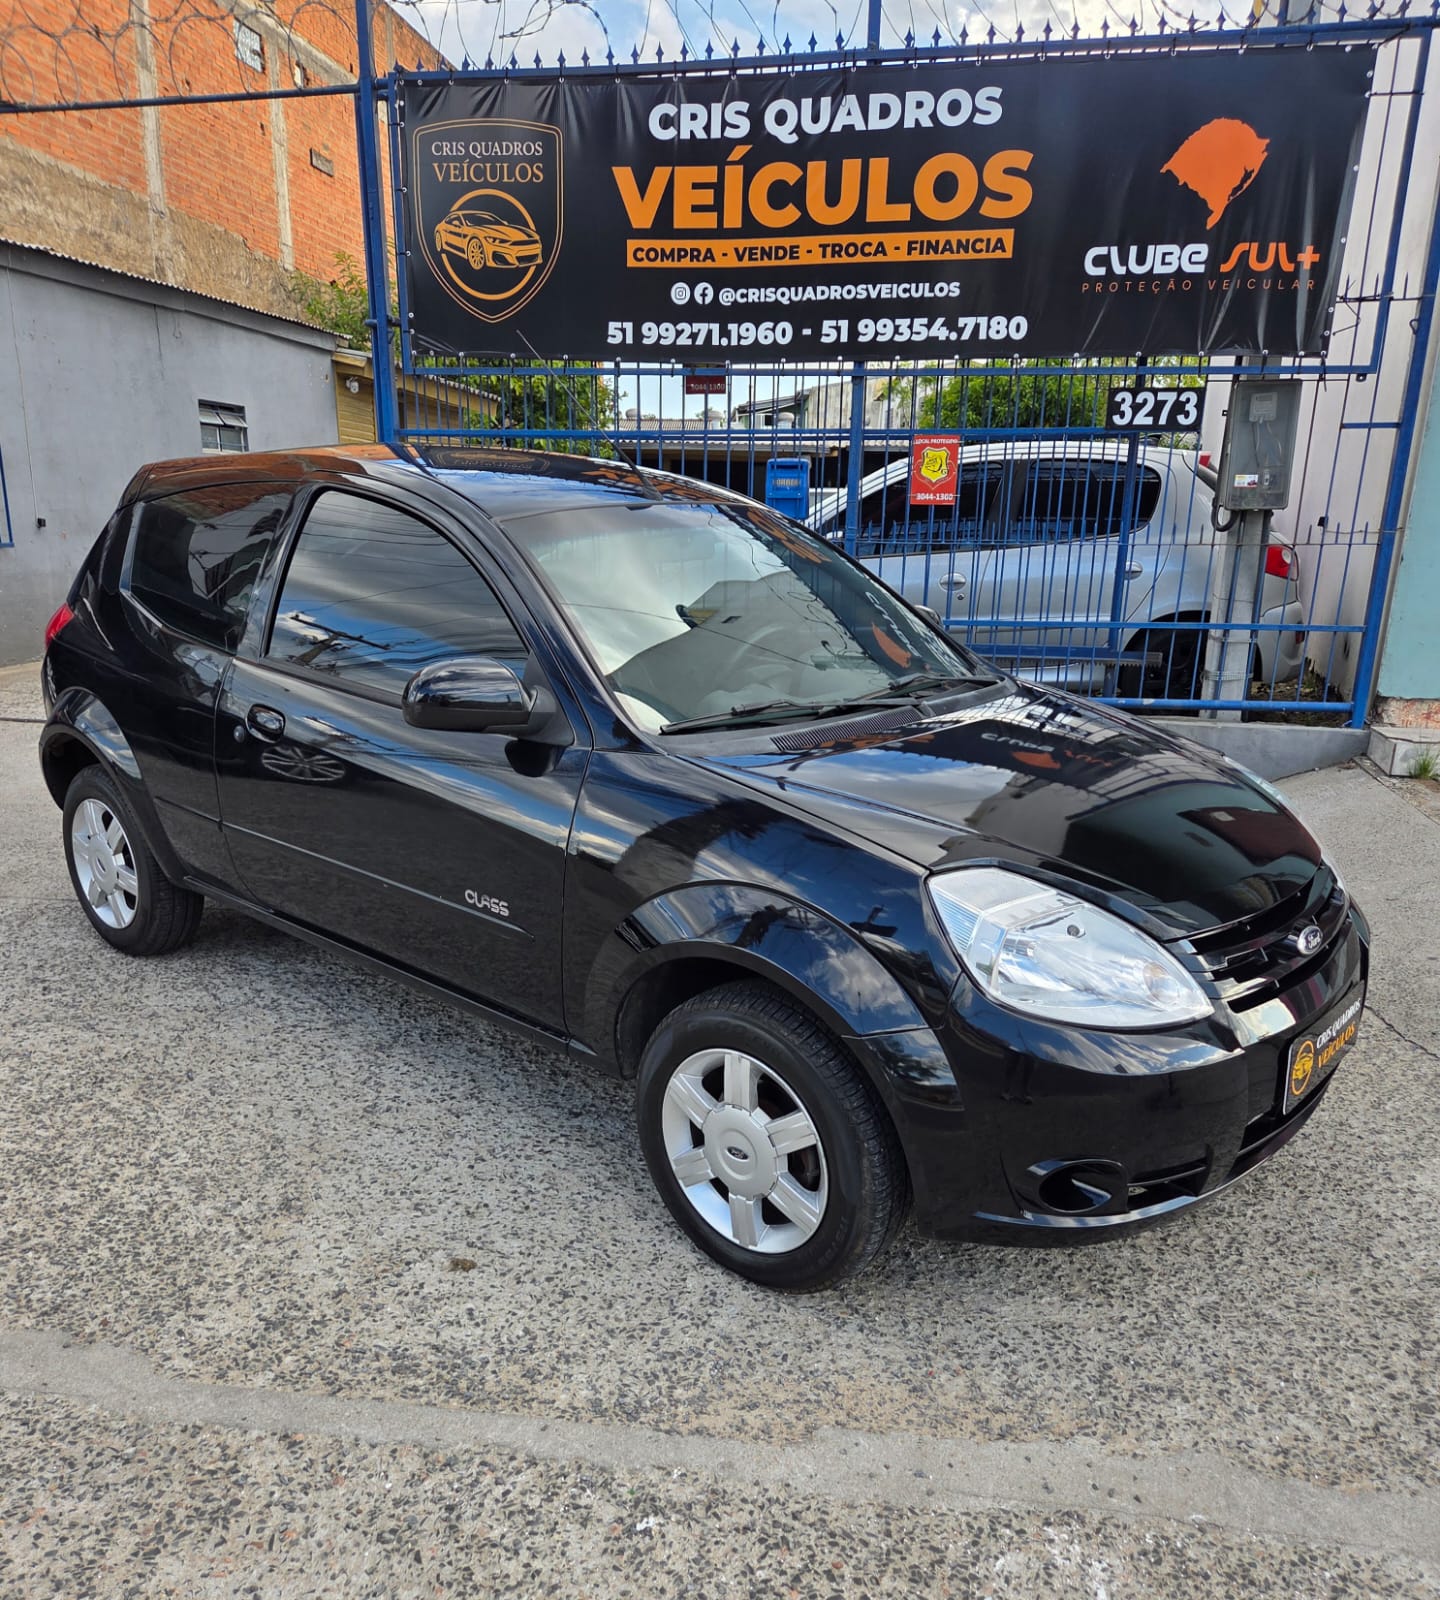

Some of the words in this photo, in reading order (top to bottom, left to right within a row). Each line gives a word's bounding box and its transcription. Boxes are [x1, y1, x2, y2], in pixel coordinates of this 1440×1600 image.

[648, 101, 751, 141] CRIS
[764, 86, 1003, 144] QUADROS
[431, 141, 465, 156] CRIS
[469, 141, 543, 159] QUADROS
[432, 159, 544, 183] VEÍCULOS
[611, 144, 1034, 229] VEÍCULOS
[632, 246, 716, 263] COMPRA
[734, 244, 800, 262] VENDE
[819, 241, 888, 259] TROCA
[906, 236, 1007, 256] FINANCIA
[1083, 243, 1209, 276] CLUBE
[719, 281, 961, 306] @CRISQUADROSVEICULOS
[1081, 278, 1193, 295] PROTEÇÃO
[1208, 278, 1316, 291] VEICULAR
[607, 322, 633, 345] 51
[641, 320, 794, 347] 99271.1960
[820, 319, 849, 343] 51
[857, 315, 1029, 343] 99354.7180
[1112, 390, 1199, 426] 3273
[464, 889, 510, 917] CLASS
[1316, 1026, 1333, 1049] CRIS
[1332, 999, 1361, 1037] QUADROS
